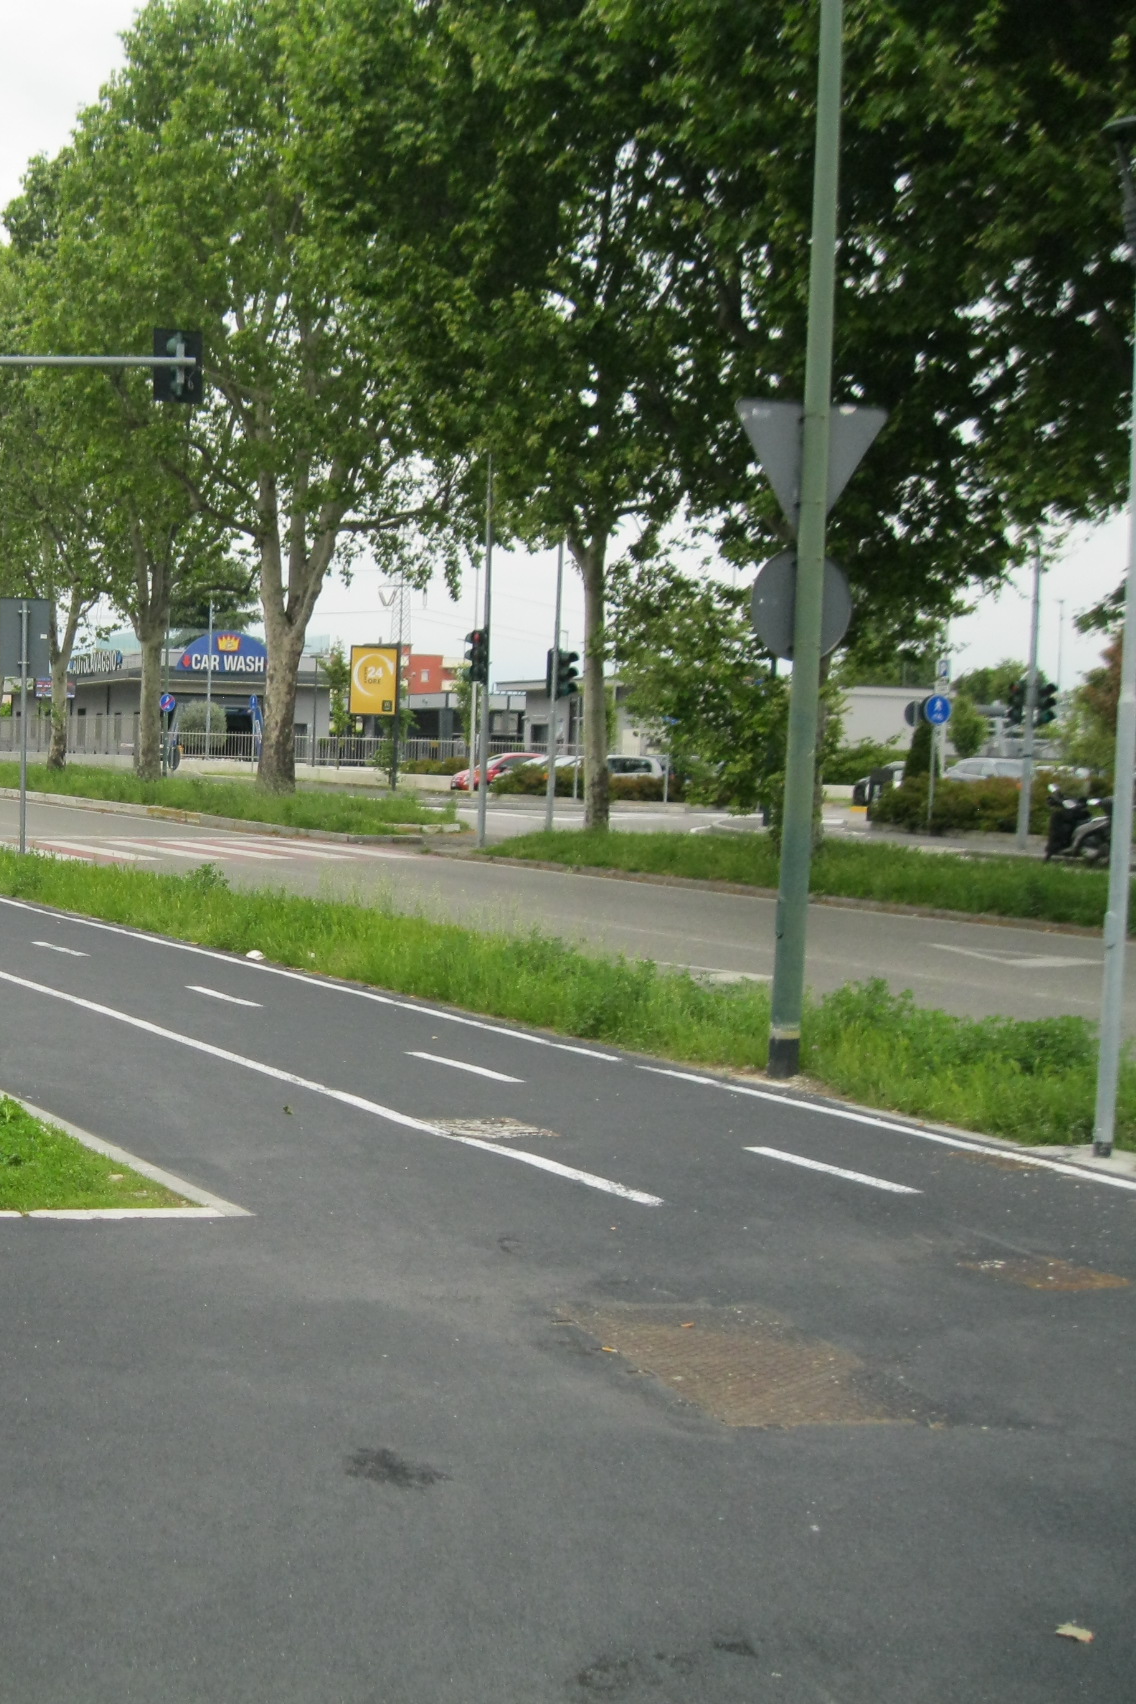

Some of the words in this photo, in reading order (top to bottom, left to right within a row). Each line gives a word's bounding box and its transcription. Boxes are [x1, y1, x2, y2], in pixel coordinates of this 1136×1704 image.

[192, 653, 219, 671] CAR
[224, 654, 264, 672] WASH
[367, 666, 383, 678] 24
